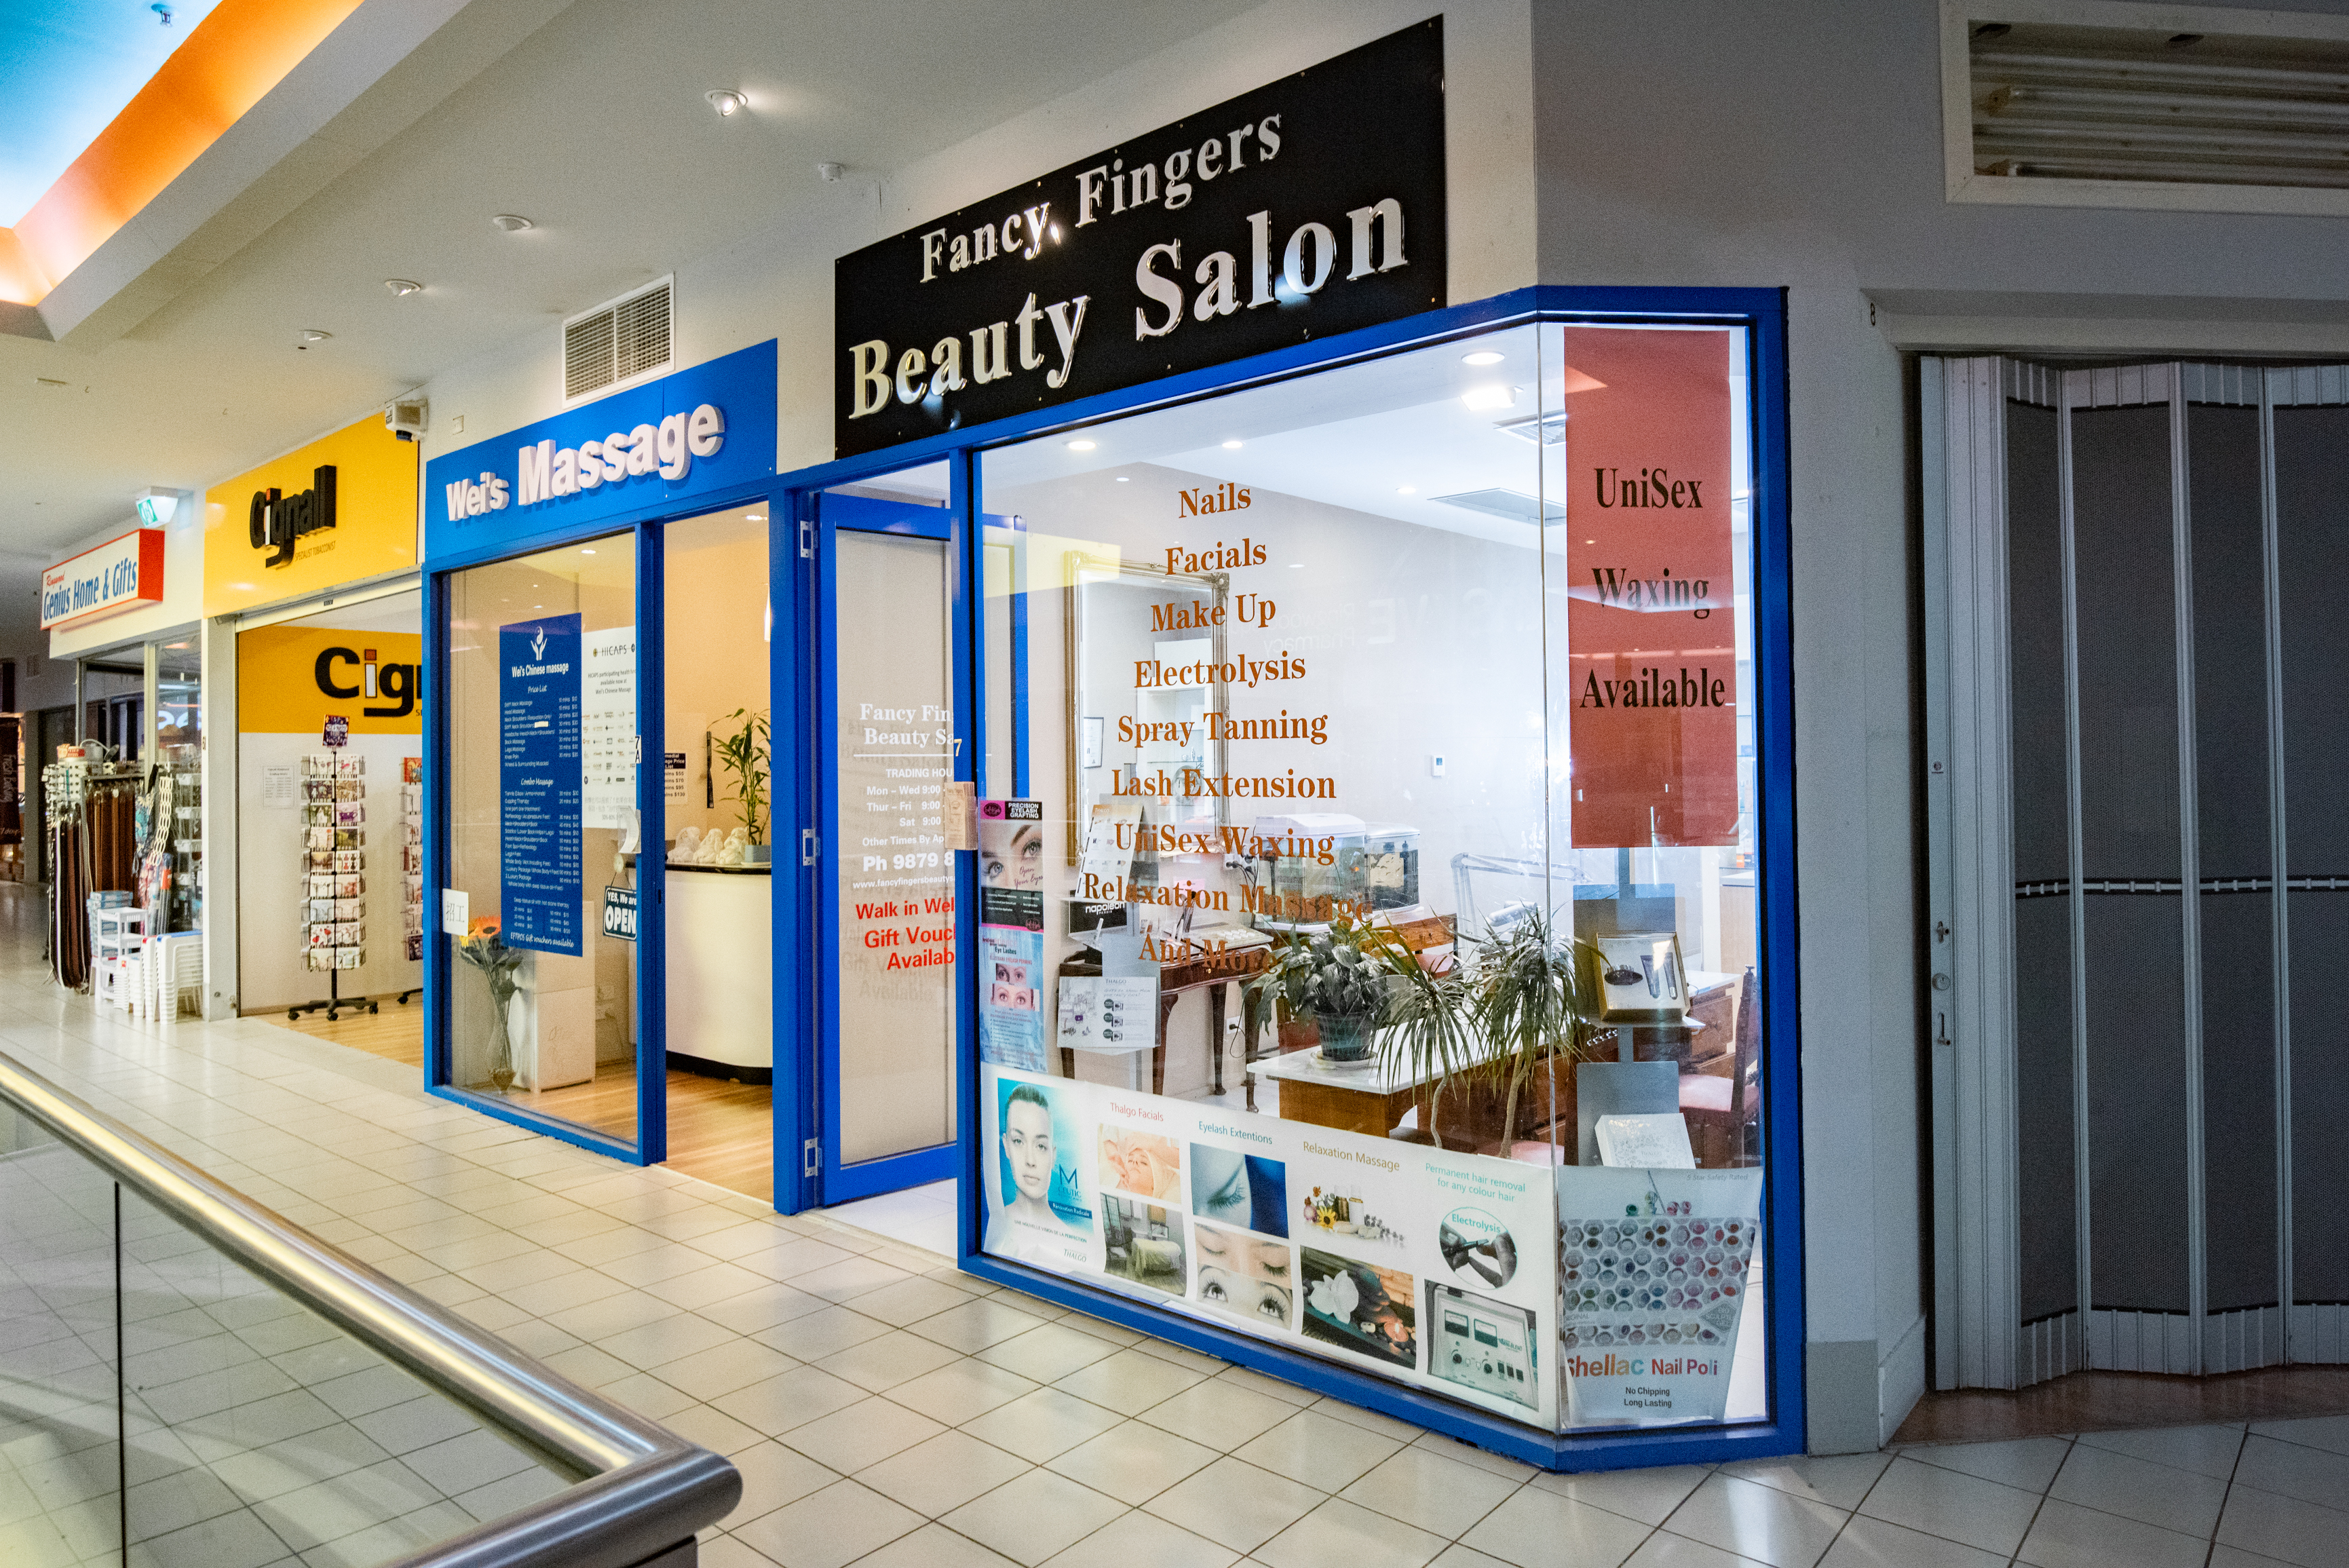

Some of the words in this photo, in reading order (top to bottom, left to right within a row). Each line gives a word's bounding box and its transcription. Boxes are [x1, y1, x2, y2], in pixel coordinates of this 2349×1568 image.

[920, 202, 1052, 284] Fancy
[1075, 113, 1282, 229] Fingers
[849, 292, 1092, 420] Beauty
[1136, 197, 1410, 342] Salon
[1870, 303, 1876, 326] 8
[446, 472, 510, 522] Wei's
[518, 404, 725, 507] Massage
[1594, 467, 1704, 509] UniSex
[1178, 482, 1252, 518] Nails
[249, 465, 337, 570] Cignall
[294, 548, 312, 562] SPECIALIST
[312, 541, 336, 556] TOBACCONIST
[1165, 537, 1267, 575] Facials
[43, 584, 71, 621] Genius
[73, 576, 99, 611] Home
[102, 567, 109, 601] &
[113, 557, 137, 598] Gifts
[1592, 567, 1710, 619] Waxing
[1150, 600, 1226, 632] Make
[1235, 593, 1276, 628] Up
[602, 645, 627, 657] HICAPS
[512, 665, 525, 678] Wei's
[526, 664, 546, 676] Chinese
[546, 663, 569, 675] massage
[1134, 650, 1306, 689] Electrolysis
[1580, 668, 1725, 709] Available
[860, 703, 917, 725] Fancy
[921, 705, 954, 723] Fin
[864, 727, 930, 748] Beauty
[1118, 715, 1196, 748] Spray
[1204, 710, 1329, 745] Tanning
[635, 736, 640, 750] 7
[954, 738, 962, 757] 7
[635, 750, 640, 763] A
[885, 768, 930, 778] TRADING
[932, 768, 953, 778] HOU
[1111, 769, 1172, 797] Lash
[1182, 768, 1337, 799] Extension
[866, 786, 888, 795] Mon
[899, 786, 920, 795] Wed
[922, 785, 941, 794] 9:00
[866, 803, 889, 811] Thur
[900, 802, 912, 811] Fri
[921, 801, 940, 810] 9:00
[900, 818, 915, 826] Sat
[922, 817, 941, 826] 9:00
[862, 837, 888, 846] Other
[890, 836, 917, 845] Times
[919, 835, 931, 845] By
[1115, 823, 1210, 854] UniSex
[1221, 826, 1335, 866] Waxing
[863, 855, 887, 871] Ph
[893, 852, 938, 870] 9879
[944, 852, 955, 866] 8
[853, 875, 955, 889] www.fancyfingersbeautys
[607, 891, 619, 904] YES,
[619, 893, 628, 903] We
[856, 901, 898, 919] Walk
[904, 900, 918, 915] in
[924, 897, 954, 913] Wel
[1084, 873, 1229, 912] Relaxation
[1240, 884, 1373, 929] Massage
[1086, 902, 1125, 915] napoleon
[605, 907, 636, 935] OPEN
[864, 928, 899, 949] Gift
[1139, 933, 1191, 965] And
[1110, 1102, 1137, 1117] Thalgo
[1138, 1108, 1164, 1122] Facials
[1199, 1121, 1229, 1136] Eyelash
[1229, 1126, 1273, 1145] Extentions
[1303, 1141, 1353, 1162] Relaxation
[1356, 1151, 1400, 1173] Massage
[1059, 1164, 1078, 1189] M
[1425, 1162, 1470, 1182] Permanent
[1472, 1172, 1489, 1186] hair
[1490, 1177, 1526, 1193] removal
[1437, 1177, 1450, 1189] for
[1451, 1183, 1467, 1194] any
[1468, 1183, 1496, 1199] colour
[1497, 1190, 1515, 1203] hair
[1451, 1213, 1501, 1234] Electrolysis
[1064, 1248, 1087, 1263] THALGO
[1651, 1358, 1683, 1375] Nail
[1687, 1359, 1717, 1376] Poli
[1626, 1387, 1636, 1395] No
[1637, 1387, 1670, 1397] Chipping
[1624, 1399, 1643, 1409] Long
[1645, 1399, 1673, 1409] Lasting
